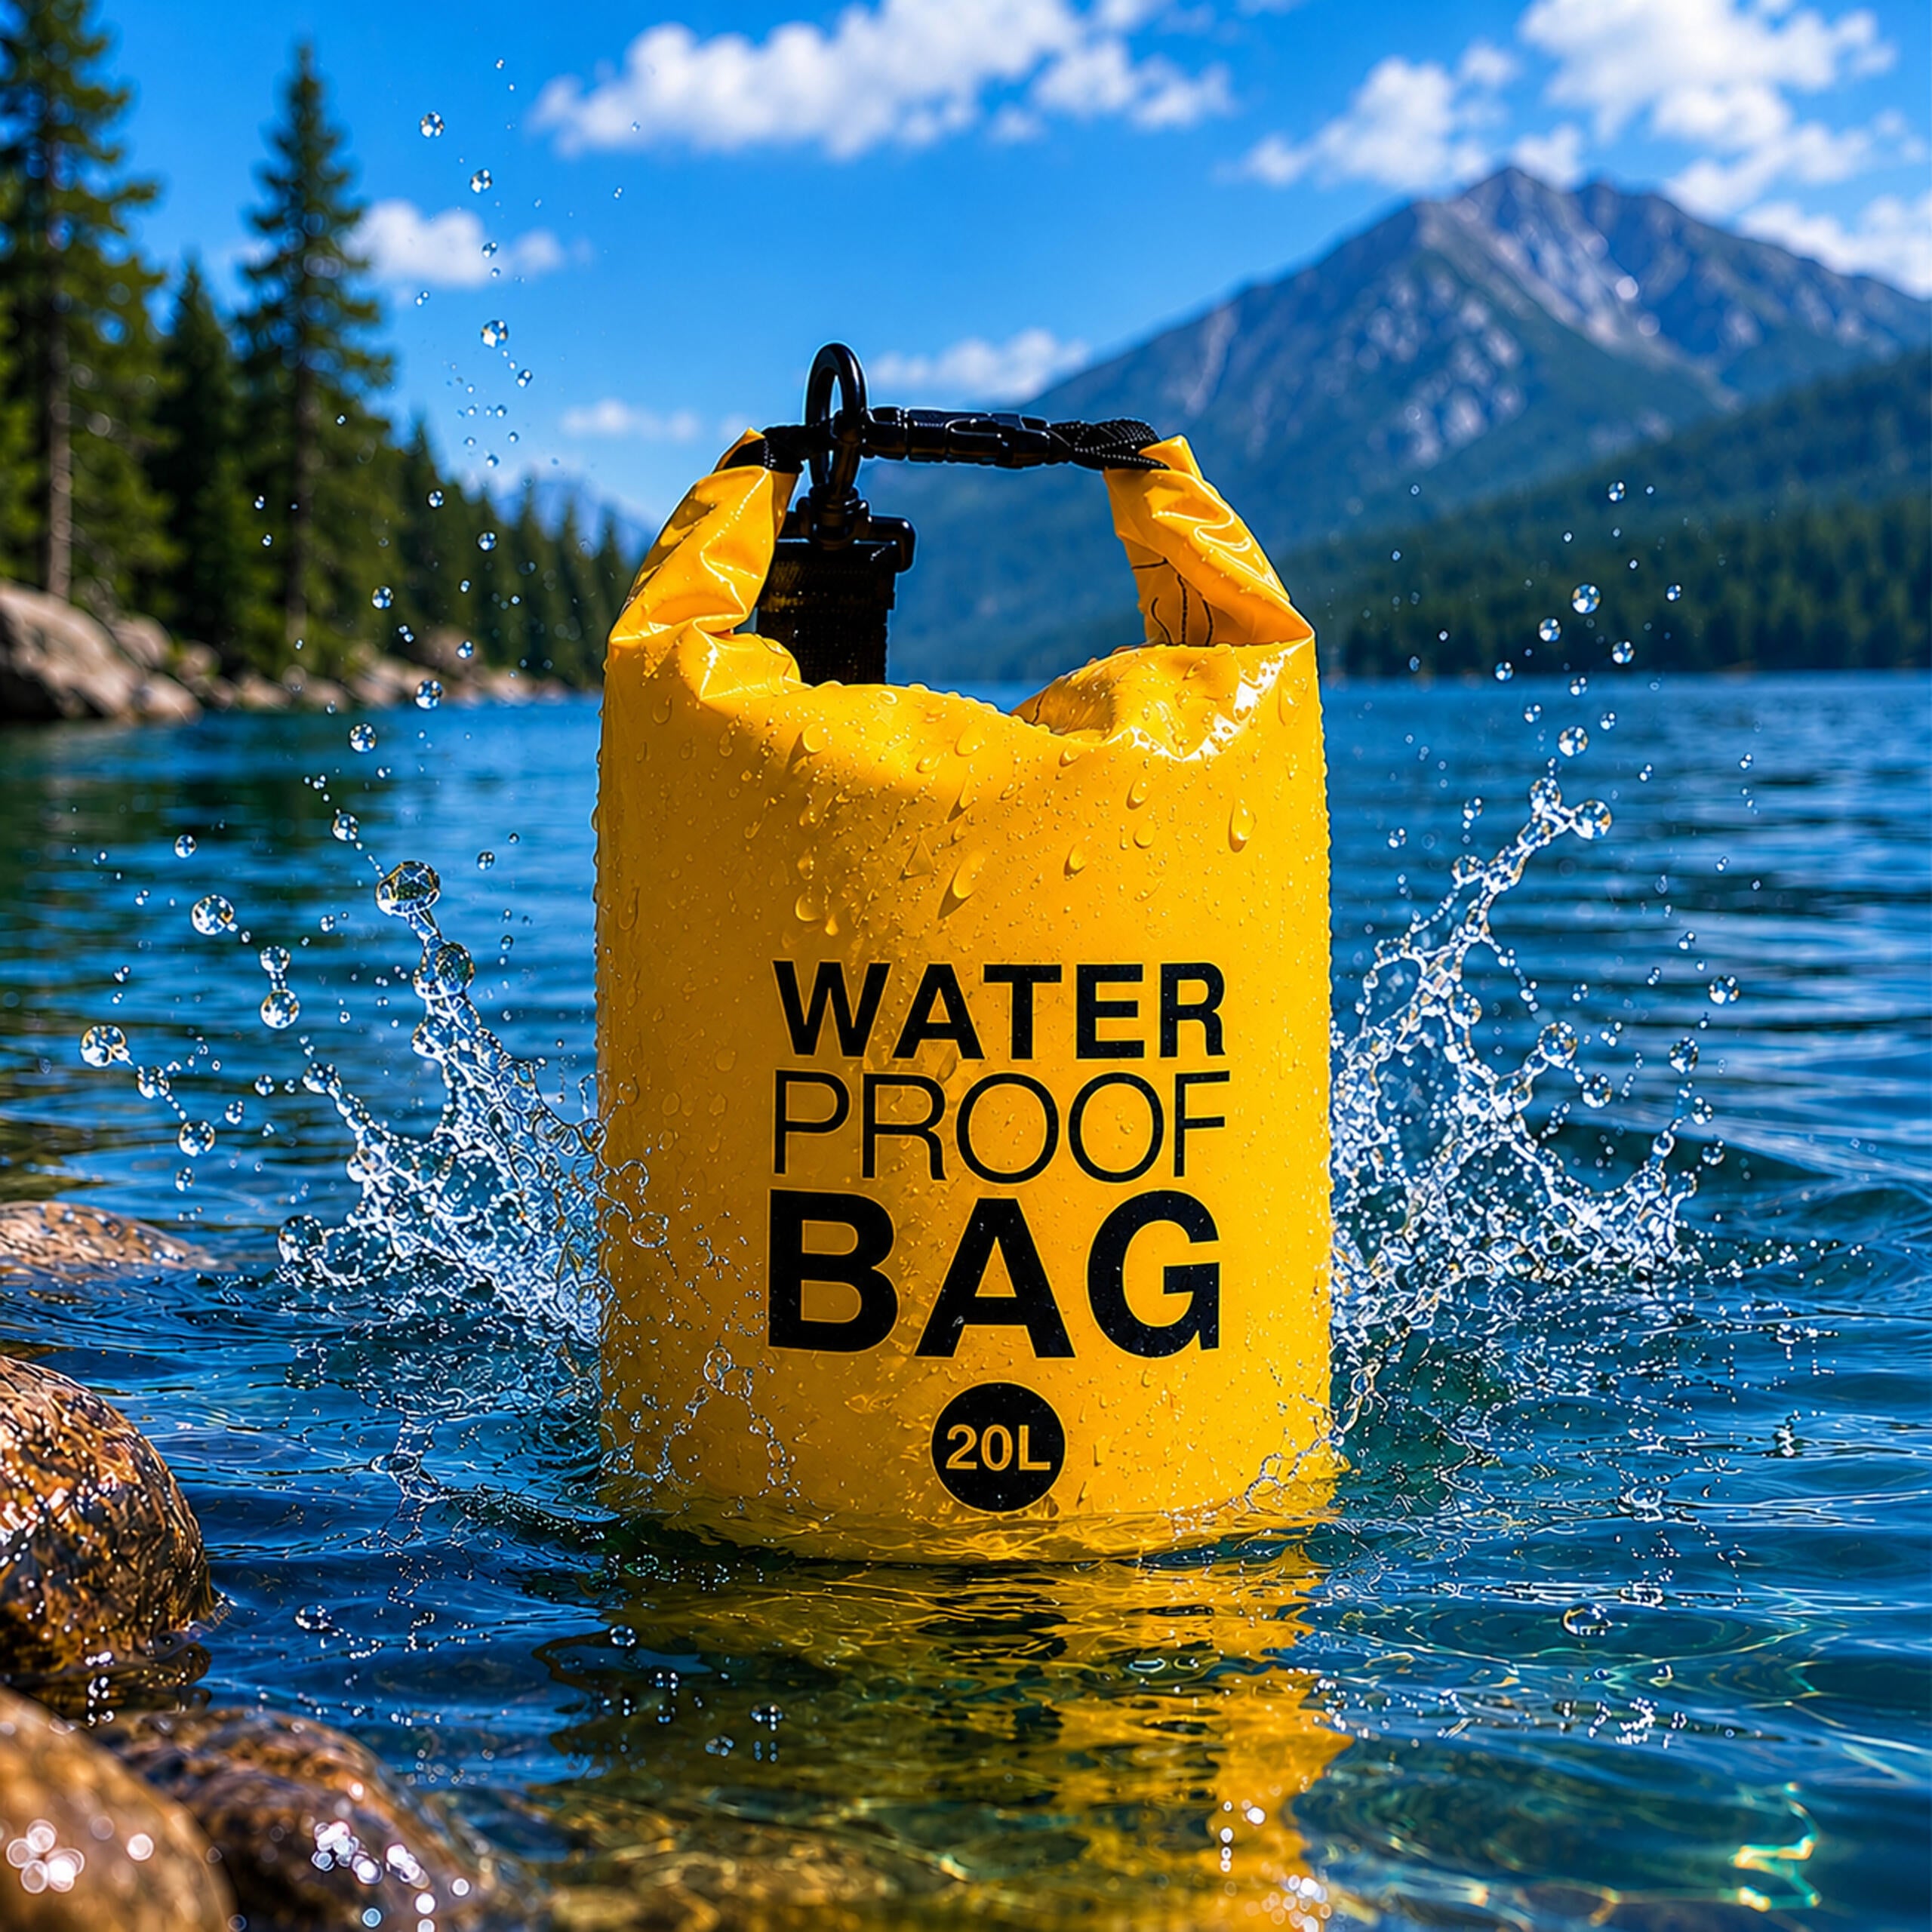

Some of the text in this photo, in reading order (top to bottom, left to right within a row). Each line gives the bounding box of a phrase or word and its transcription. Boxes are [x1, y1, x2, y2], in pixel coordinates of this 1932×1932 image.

[772, 960, 1226, 1060] WATER
[774, 1069, 1230, 1184] PROOF
[768, 1189, 1220, 1358] BAG
[946, 1424, 1051, 1471] 20L
